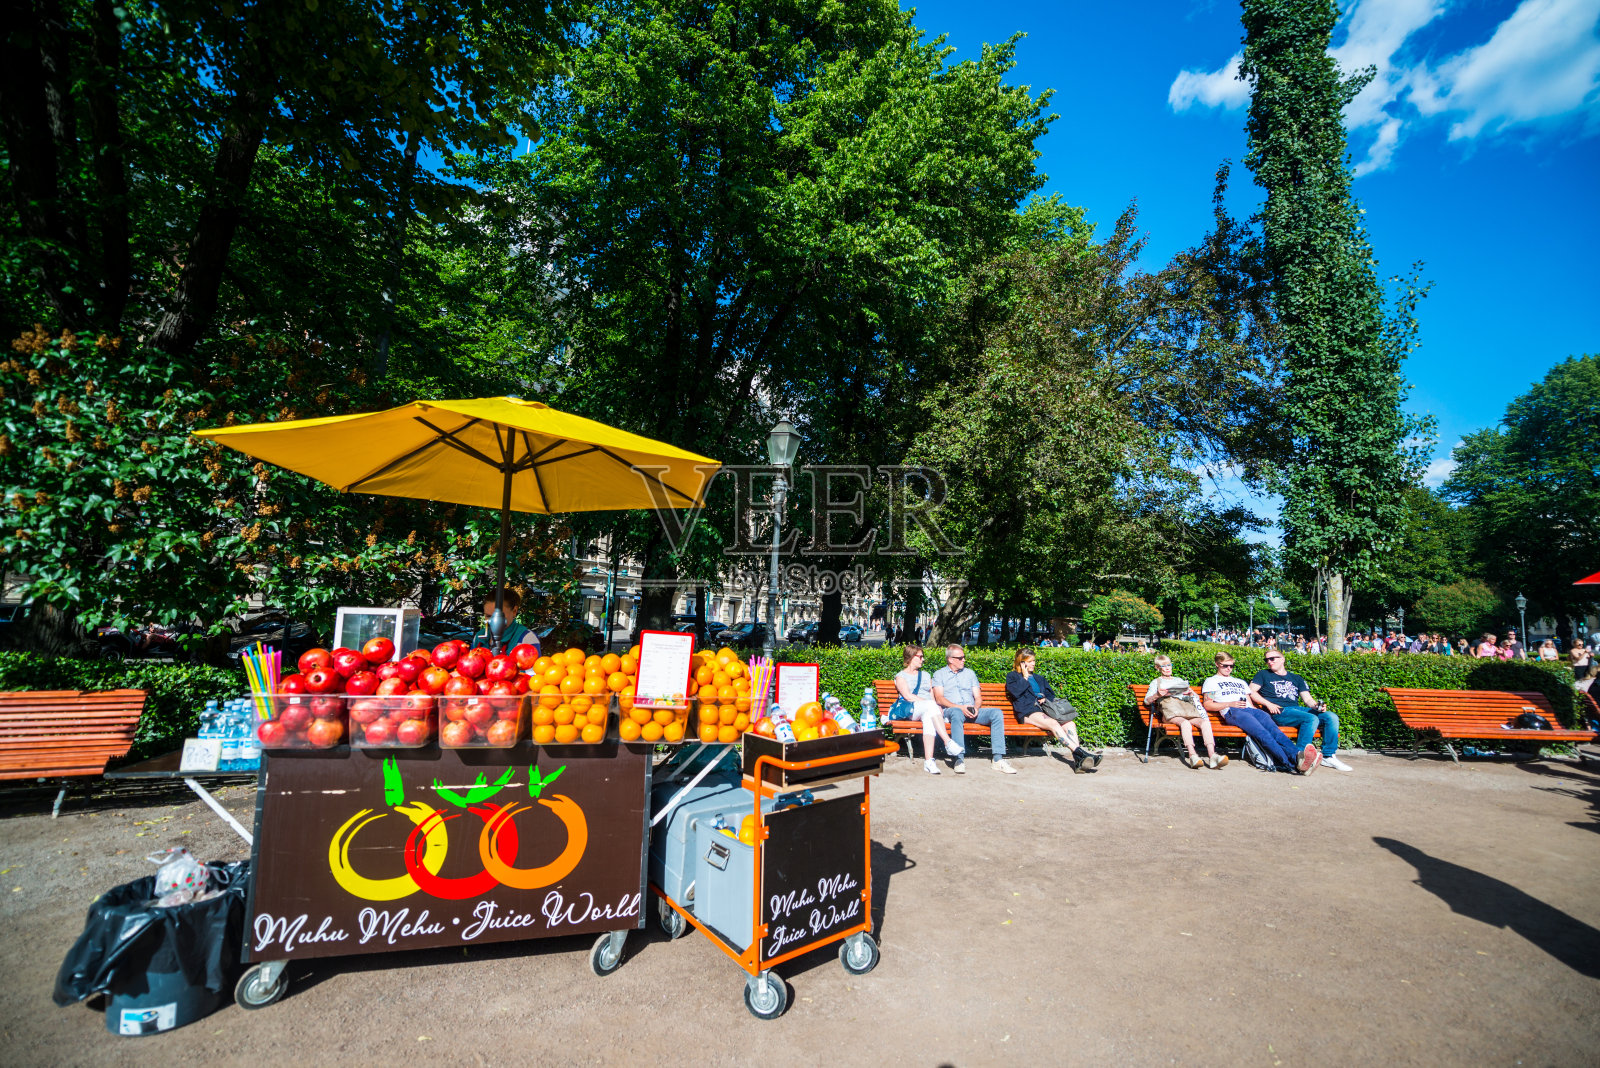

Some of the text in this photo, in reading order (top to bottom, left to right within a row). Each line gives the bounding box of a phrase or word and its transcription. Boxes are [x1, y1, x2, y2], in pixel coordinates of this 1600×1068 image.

[254, 890, 642, 952] Muhu Mehu Juice World
[770, 873, 857, 921] Muhu Mehu
[768, 898, 860, 957] Juice World
